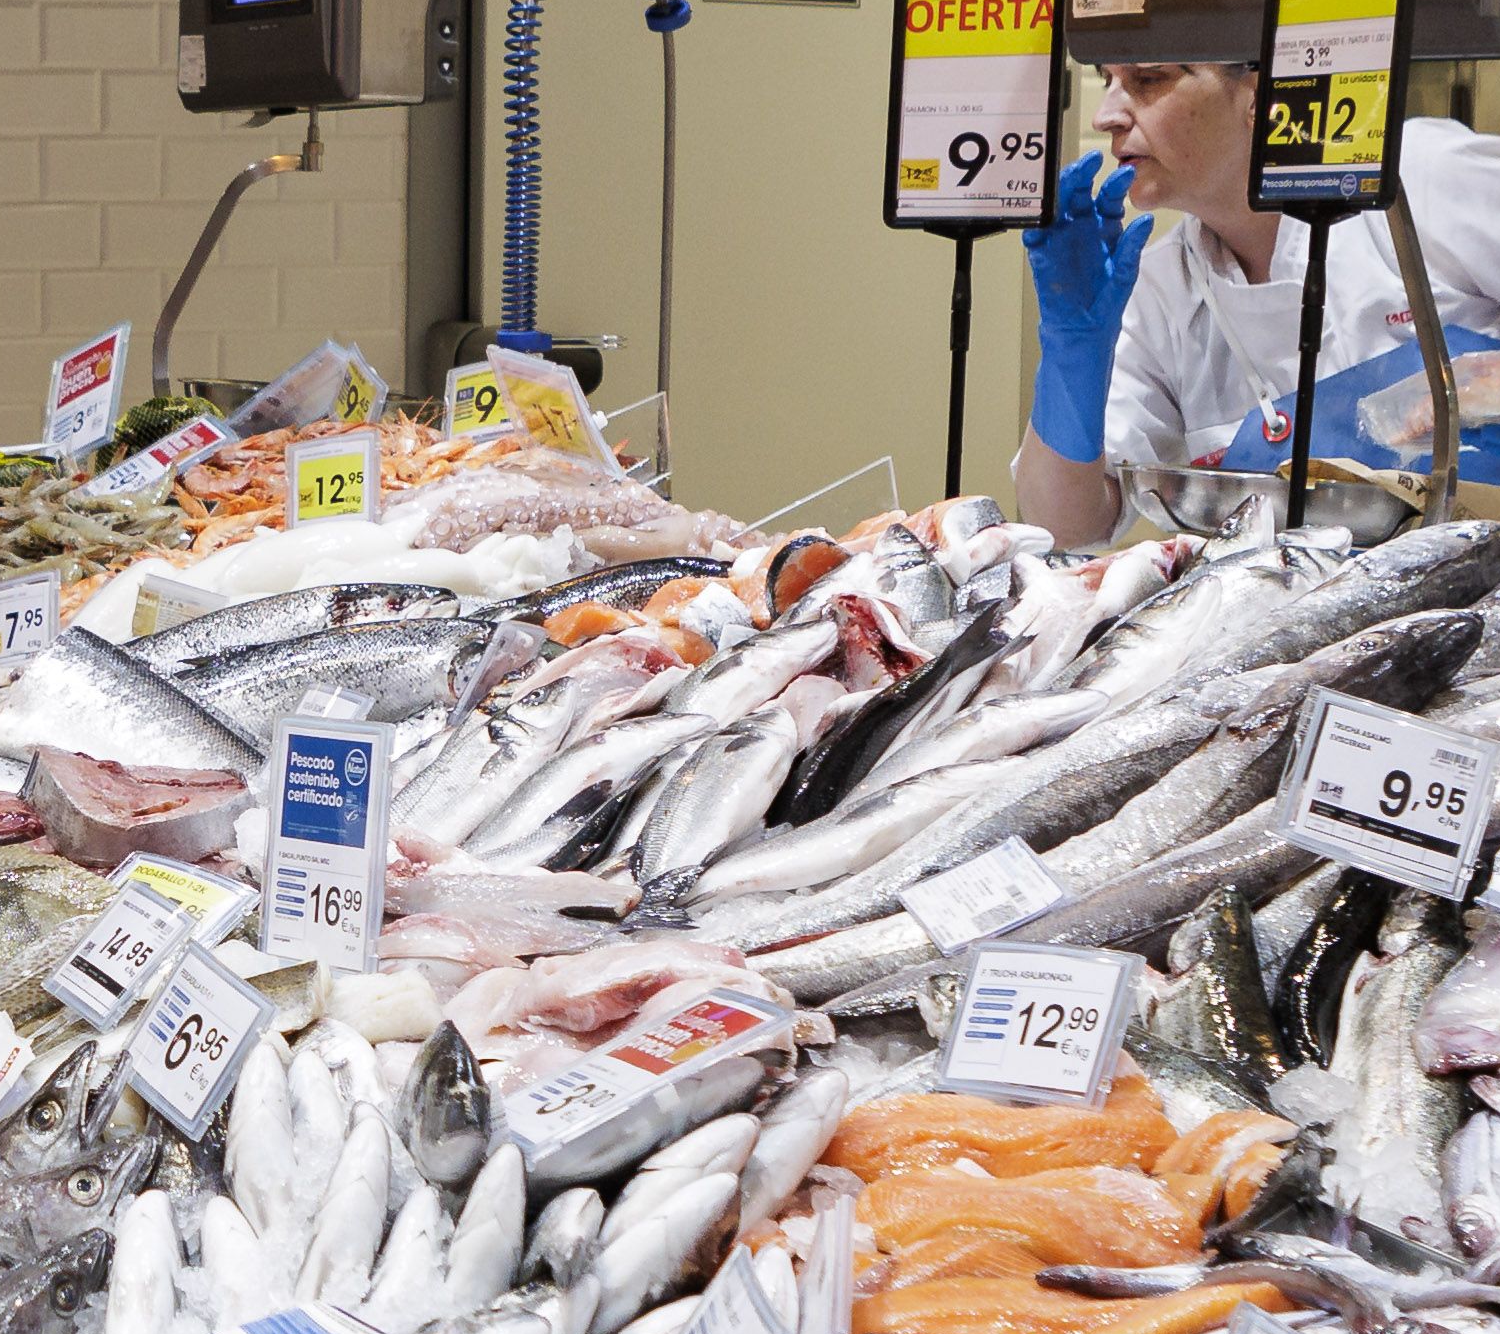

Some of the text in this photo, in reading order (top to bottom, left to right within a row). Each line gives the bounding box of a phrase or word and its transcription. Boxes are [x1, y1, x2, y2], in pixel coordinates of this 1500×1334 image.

[1339, 75, 1348, 85] La
[1350, 73, 1378, 84] unidad
[1268, 101, 1323, 145] 2x1
[948, 131, 1045, 187] 9,95
[1006, 179, 1038, 193] €/Kg
[1262, 178, 1340, 189] Pescado responsable
[62, 366, 92, 389] buen
[315, 471, 364, 506] 12,95
[5, 608, 43, 649] 7,95
[290, 751, 335, 771] Pescado
[289, 770, 340, 790] sostenible
[1379, 769, 1468, 818] 9,95
[288, 788, 343, 808] certificado
[311, 883, 362, 927] 16,99
[100, 927, 154, 967] 14,95
[989, 969, 1018, 979] TRUCHA
[1020, 971, 1073, 983] ASALMONADA
[164, 1013, 229, 1070] 6,95
[1019, 1001, 1099, 1049] 12,99
